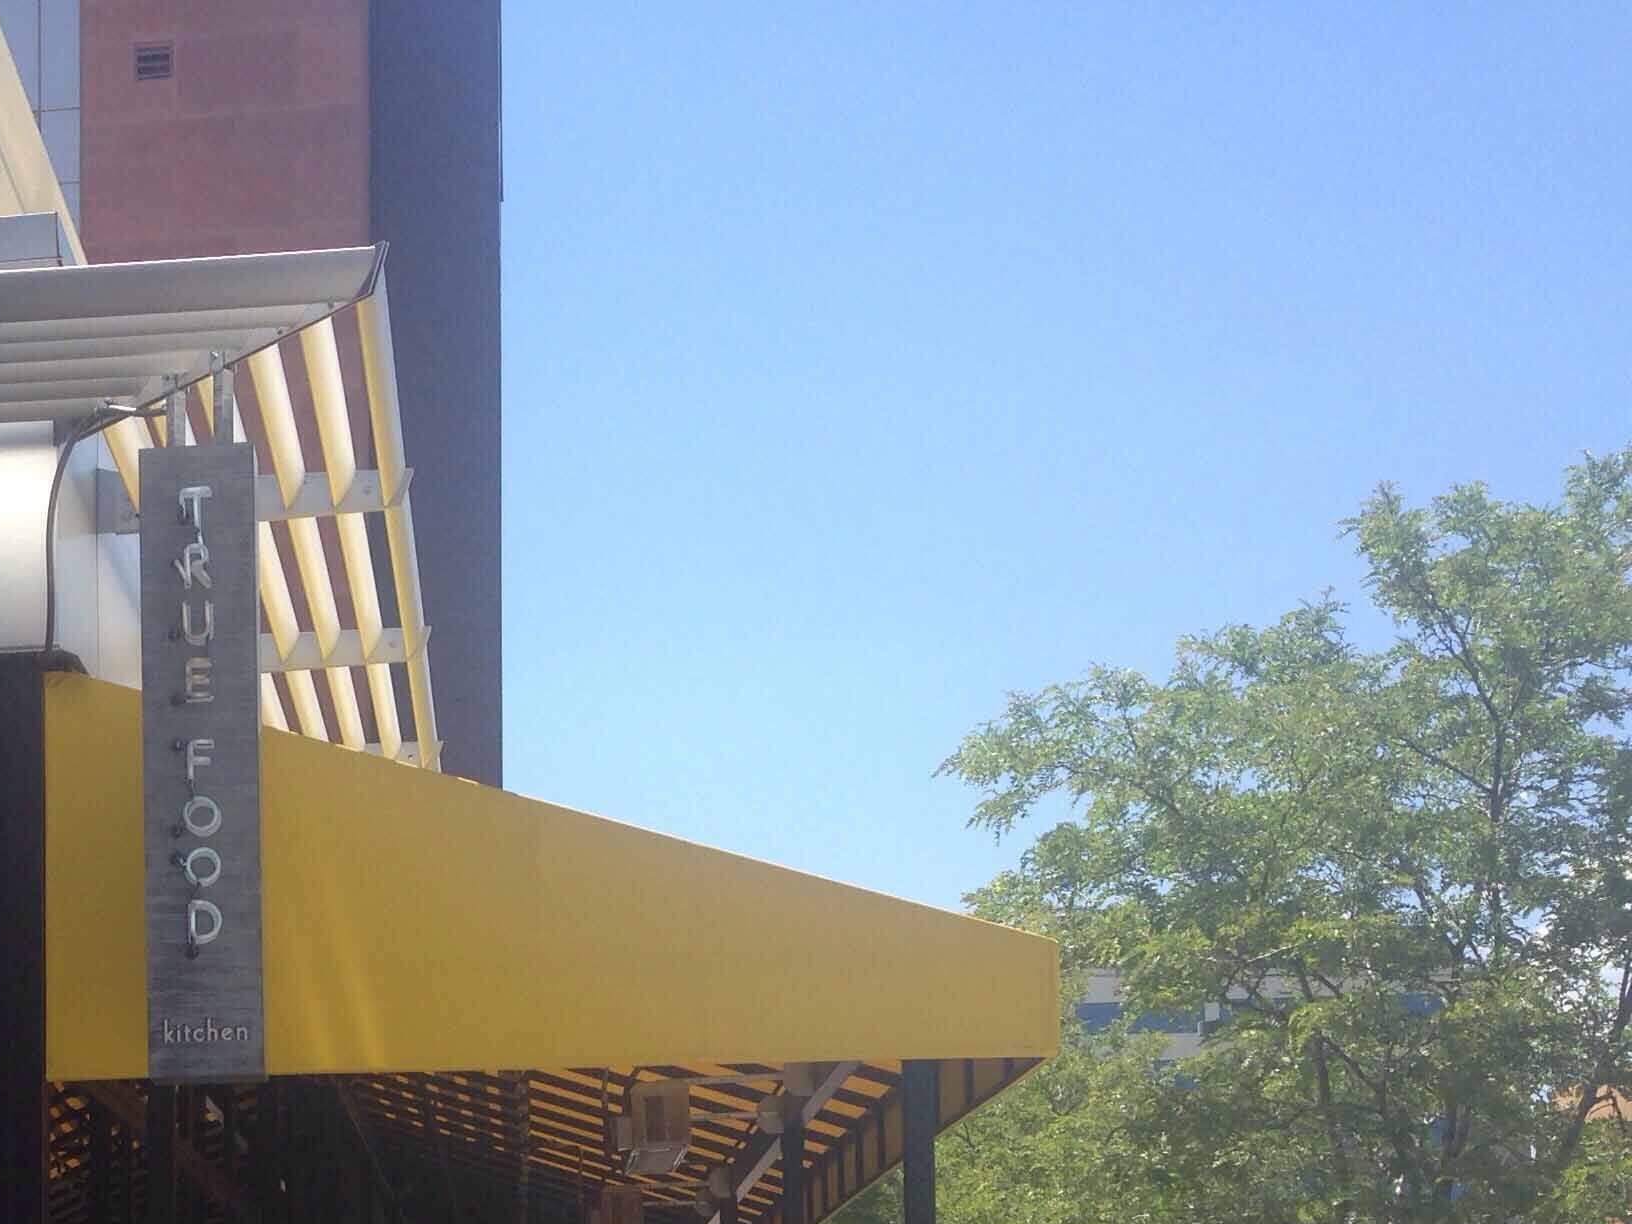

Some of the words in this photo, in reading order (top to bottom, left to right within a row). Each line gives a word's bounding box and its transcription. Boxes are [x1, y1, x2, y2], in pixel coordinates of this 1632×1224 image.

[175, 486, 216, 705] TRUE
[183, 739, 223, 948] FOOD
[163, 1020, 250, 1044] kitchen
